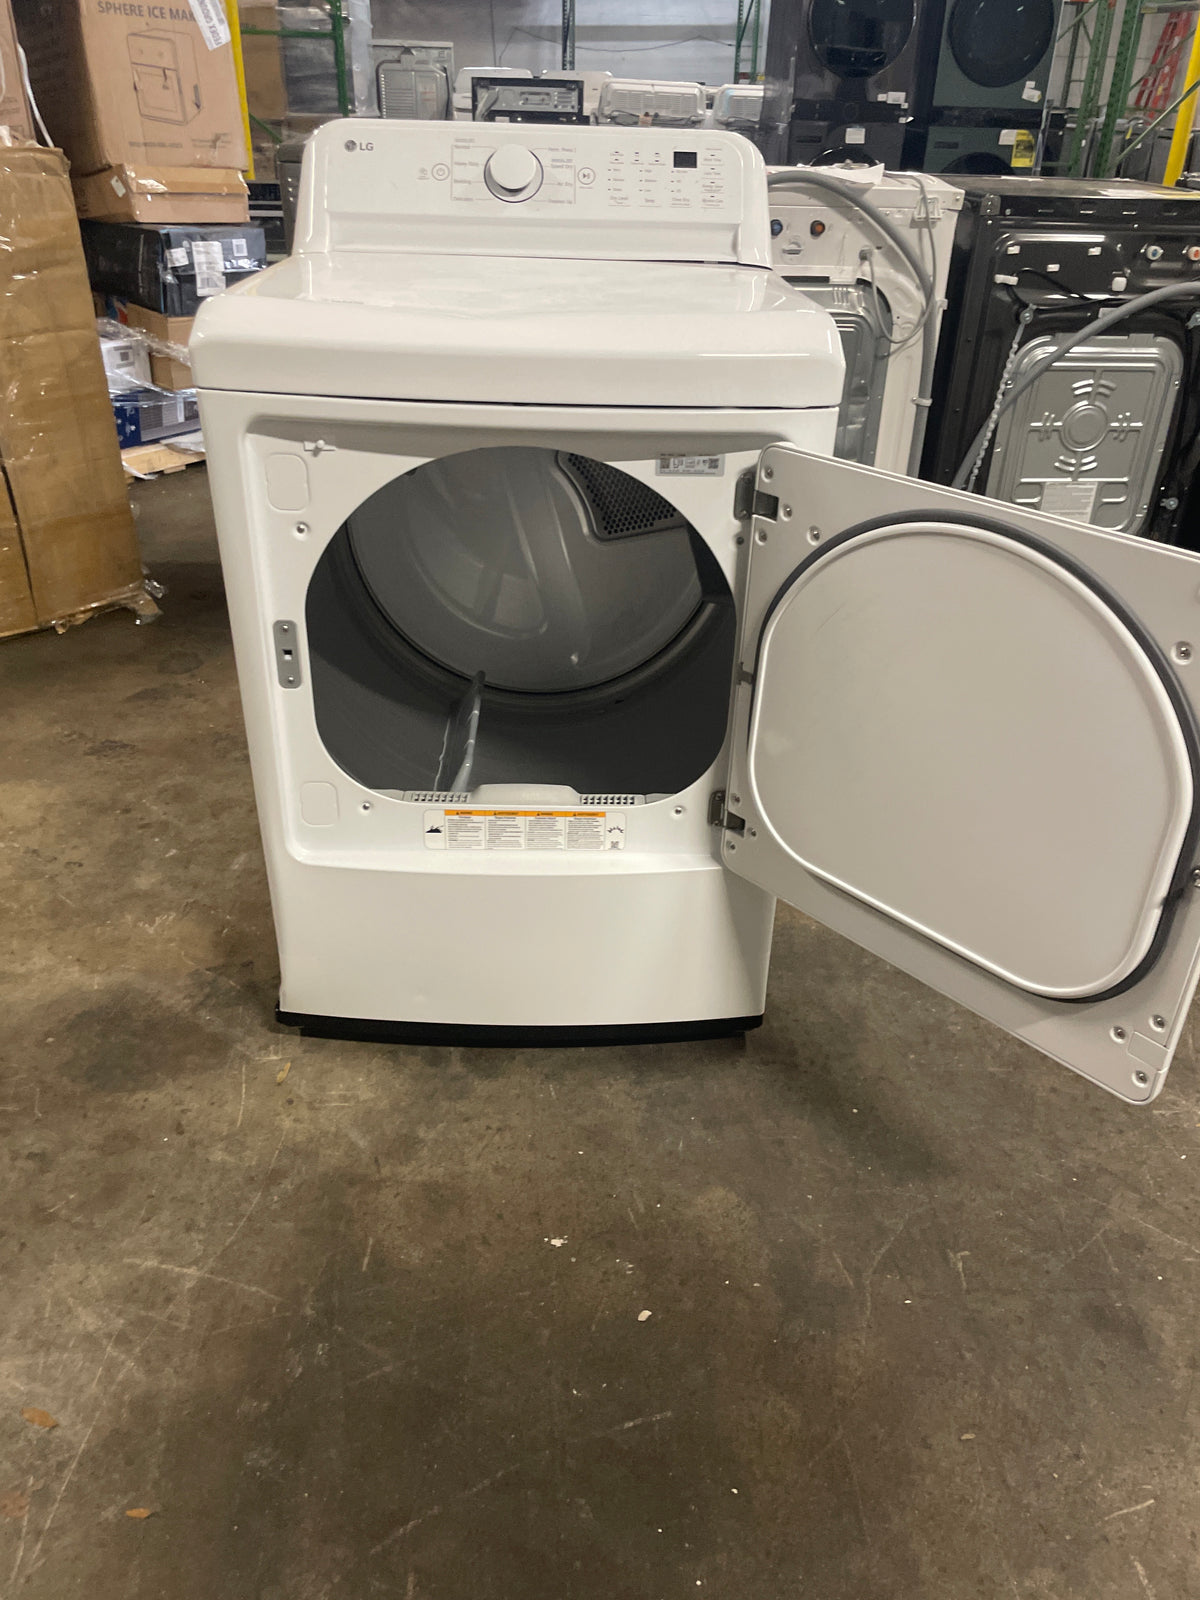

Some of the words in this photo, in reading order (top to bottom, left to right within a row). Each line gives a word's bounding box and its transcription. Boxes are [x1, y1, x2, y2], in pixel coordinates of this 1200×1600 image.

[97, 1, 144, 18] SPHERE
[147, 5, 167, 20] ICE
[359, 142, 374, 151] LG
